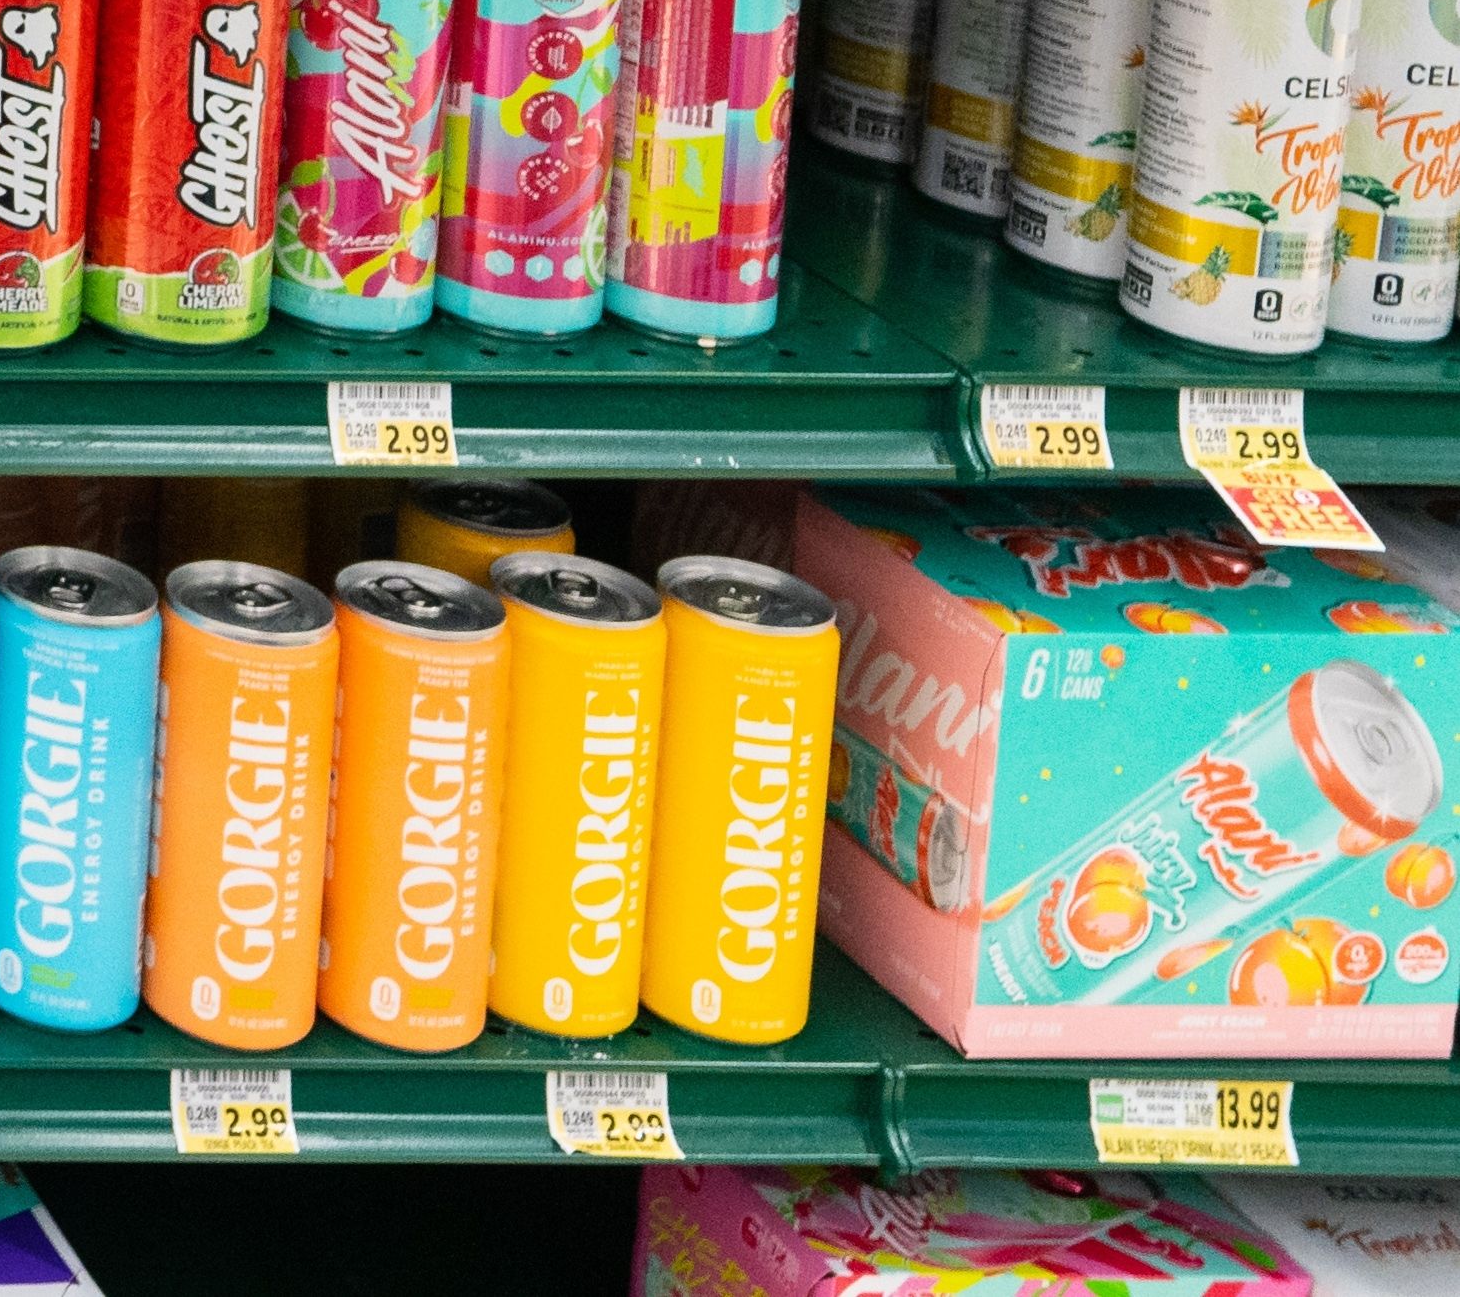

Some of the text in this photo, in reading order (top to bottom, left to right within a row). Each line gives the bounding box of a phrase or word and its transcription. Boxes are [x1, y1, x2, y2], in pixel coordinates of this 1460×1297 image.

[716, 694, 795, 981] GORGIE
[227, 1108, 287, 1138] 2.99
[1216, 1088, 1280, 1130] 13.99
